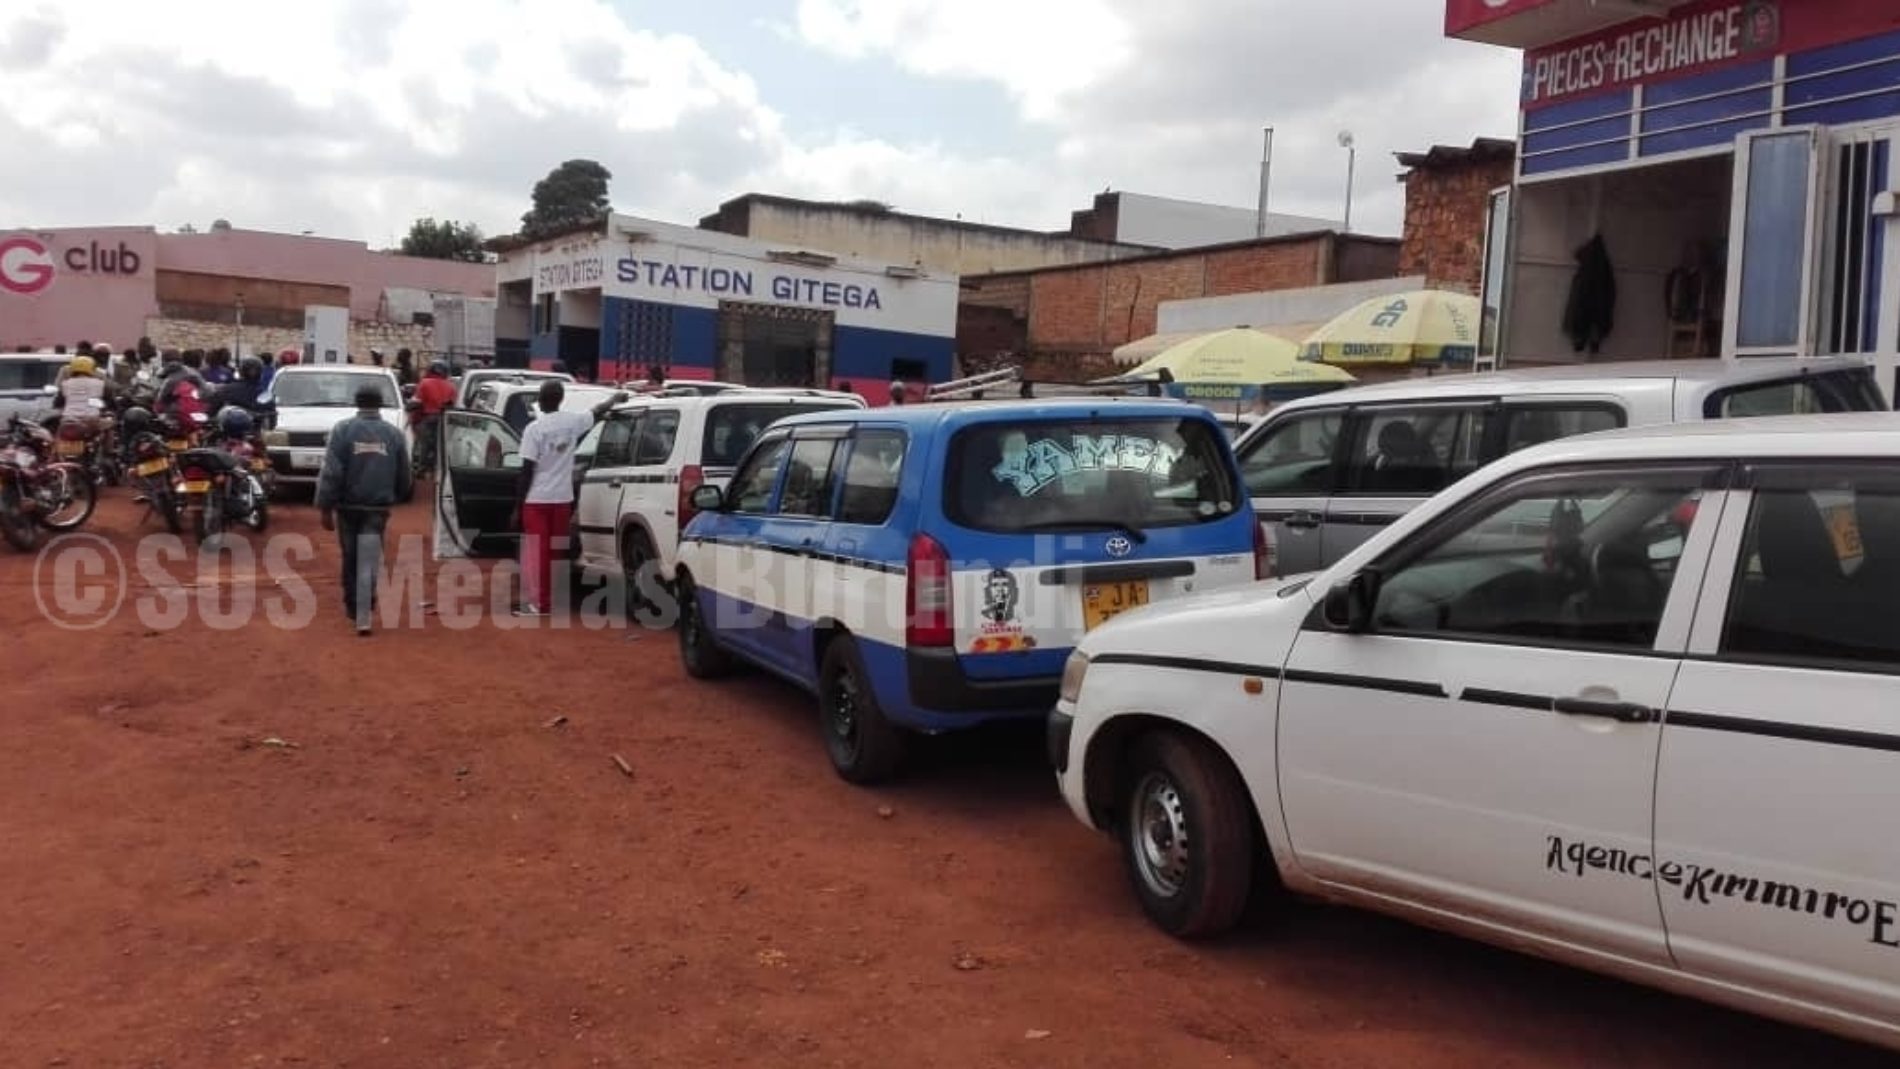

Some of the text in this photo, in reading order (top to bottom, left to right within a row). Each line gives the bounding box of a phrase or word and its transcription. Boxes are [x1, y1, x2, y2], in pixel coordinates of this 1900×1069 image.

[1534, 41, 1605, 101] PIECES
[1613, 5, 1742, 83] RECHANGE
[64, 240, 140, 274] club
[616, 257, 882, 311] STATION GITEGA
